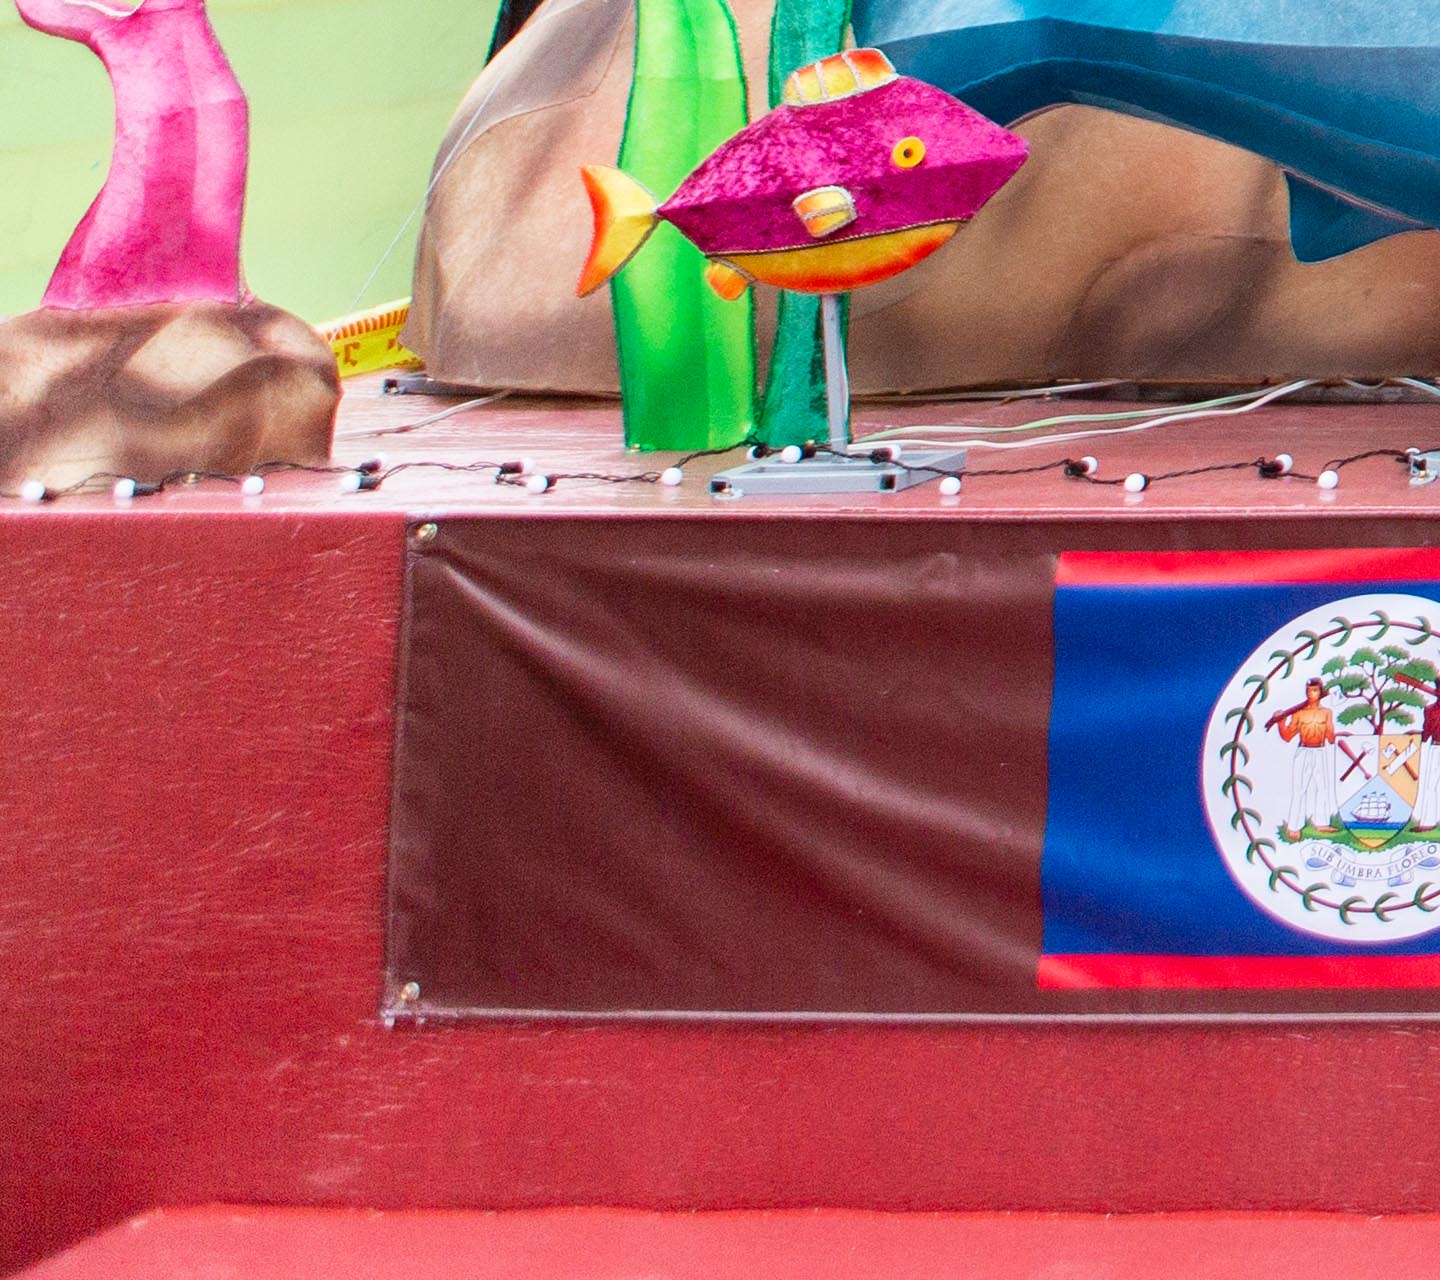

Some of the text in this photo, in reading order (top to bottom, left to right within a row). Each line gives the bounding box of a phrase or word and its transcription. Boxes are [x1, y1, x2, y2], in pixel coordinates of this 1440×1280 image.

[1310, 844, 1438, 879] SUB UMBRA FLOREO
